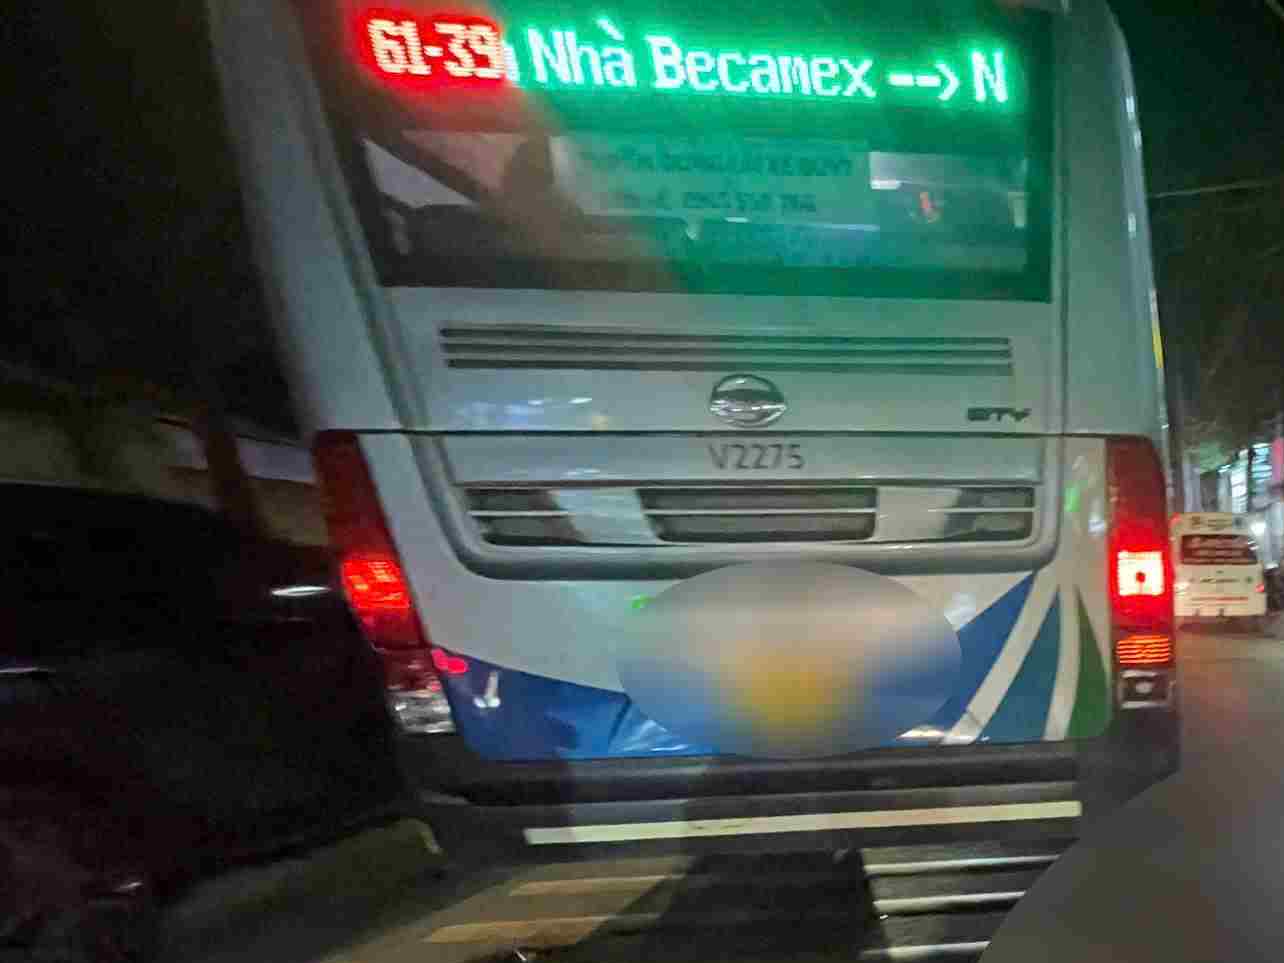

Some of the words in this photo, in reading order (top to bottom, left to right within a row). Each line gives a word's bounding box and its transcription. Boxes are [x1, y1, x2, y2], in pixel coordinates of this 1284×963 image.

[526, 17, 637, 87] Nhà
[645, 34, 876, 98] Becamex
[706, 443, 806, 471] V2275
